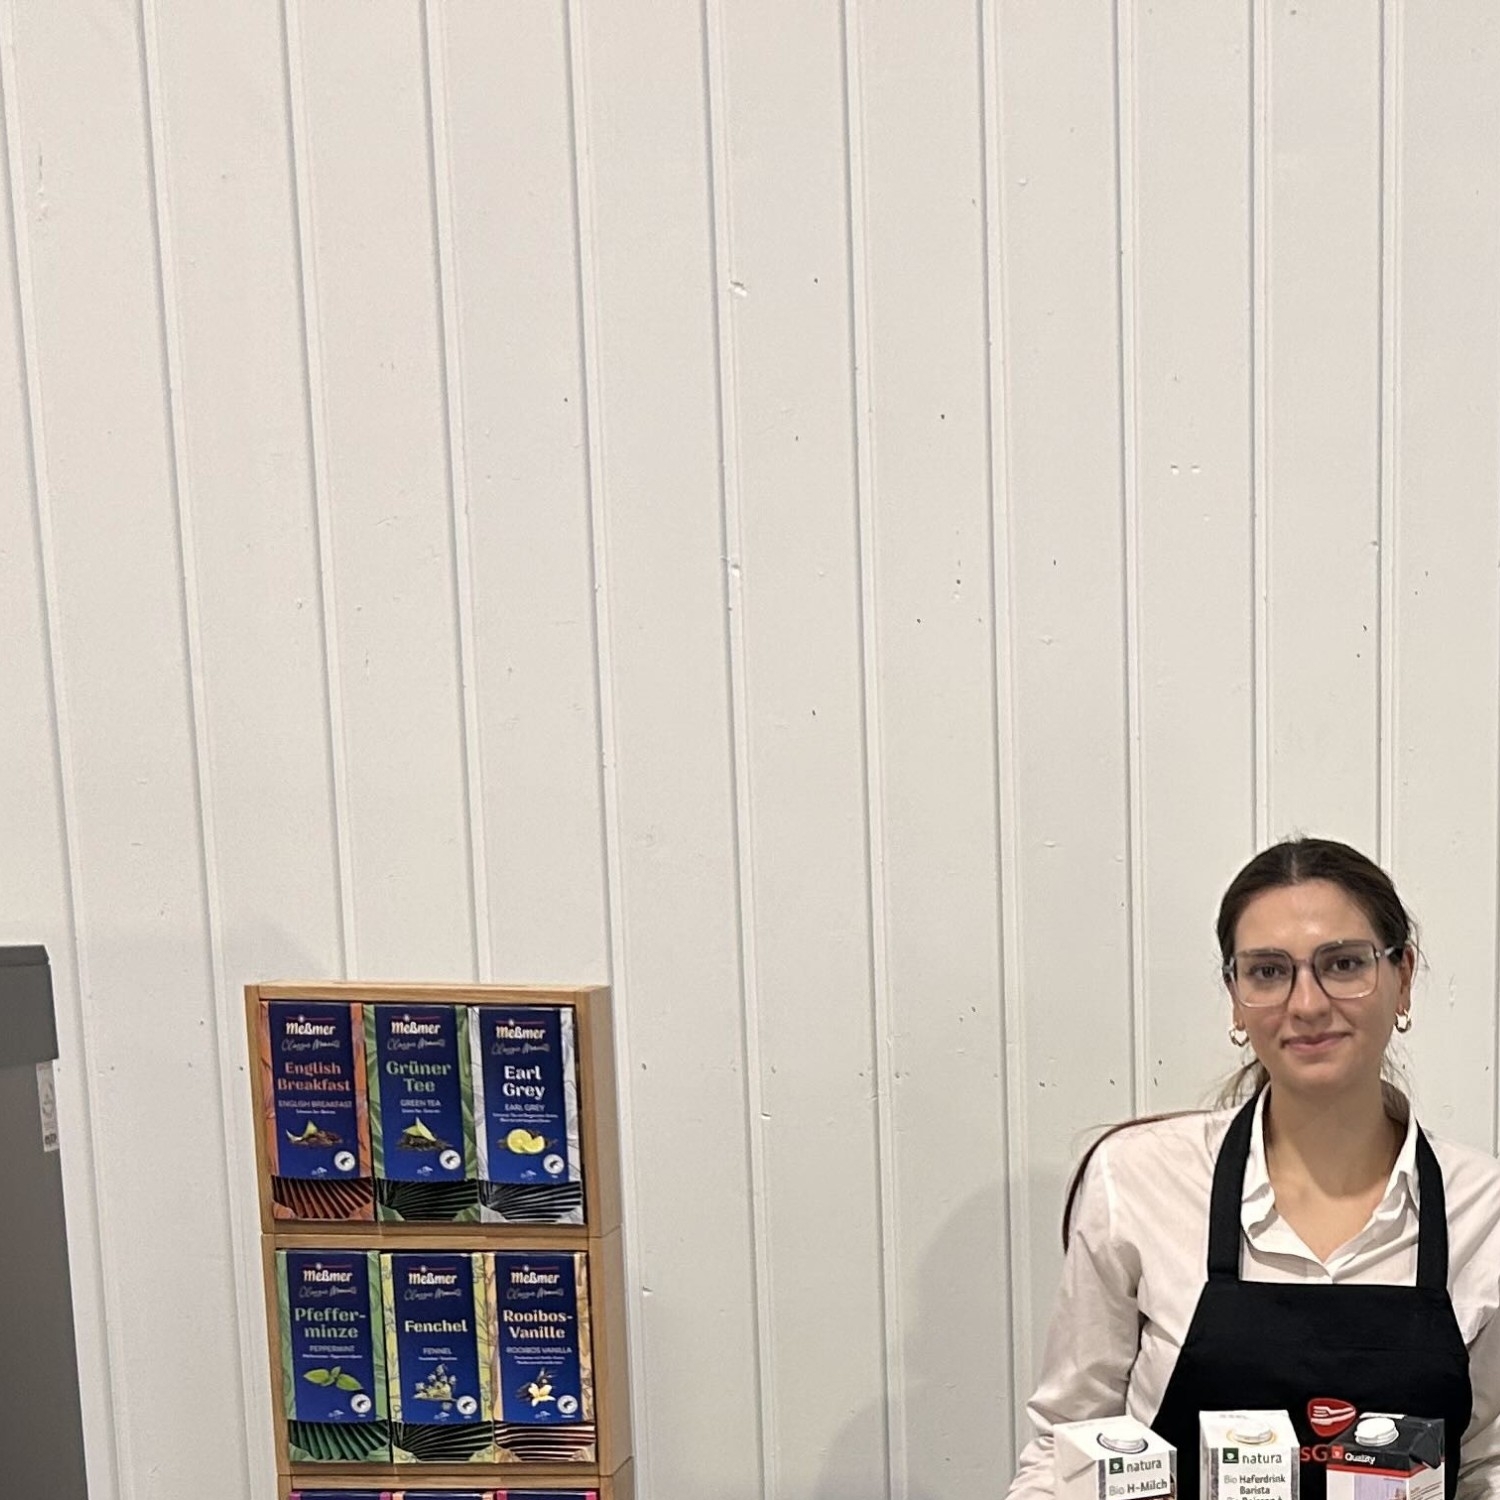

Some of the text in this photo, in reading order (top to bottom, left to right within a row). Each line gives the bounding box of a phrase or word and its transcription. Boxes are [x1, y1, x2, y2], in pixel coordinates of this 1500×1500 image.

[285, 1022, 336, 1035] Meßmer
[391, 1021, 441, 1035] Meßmer
[495, 1026, 546, 1039] Meßmer
[284, 1062, 342, 1077] English
[385, 1060, 452, 1075] Grüner
[504, 1065, 542, 1080] Earl
[277, 1078, 351, 1092] Breakfast
[403, 1078, 436, 1093] Tee
[502, 1082, 546, 1100] Grey
[303, 1269, 353, 1282] Meßmer
[408, 1272, 458, 1285] Meßmer
[510, 1271, 560, 1284] Meßmer
[294, 1307, 366, 1322] Pfeffer-
[503, 1309, 573, 1322] Rooibos-
[304, 1323, 359, 1339] minze
[404, 1319, 468, 1333] Fenchel
[508, 1325, 566, 1339] Vanille
[1242, 1453, 1283, 1464] natura
[1344, 1452, 1376, 1465] Quality
[1126, 1460, 1162, 1472] natura
[1239, 1474, 1286, 1484] Haferdrink
[1109, 1479, 1168, 1496] Bio H-Milch
[1240, 1485, 1271, 1495] Barista
